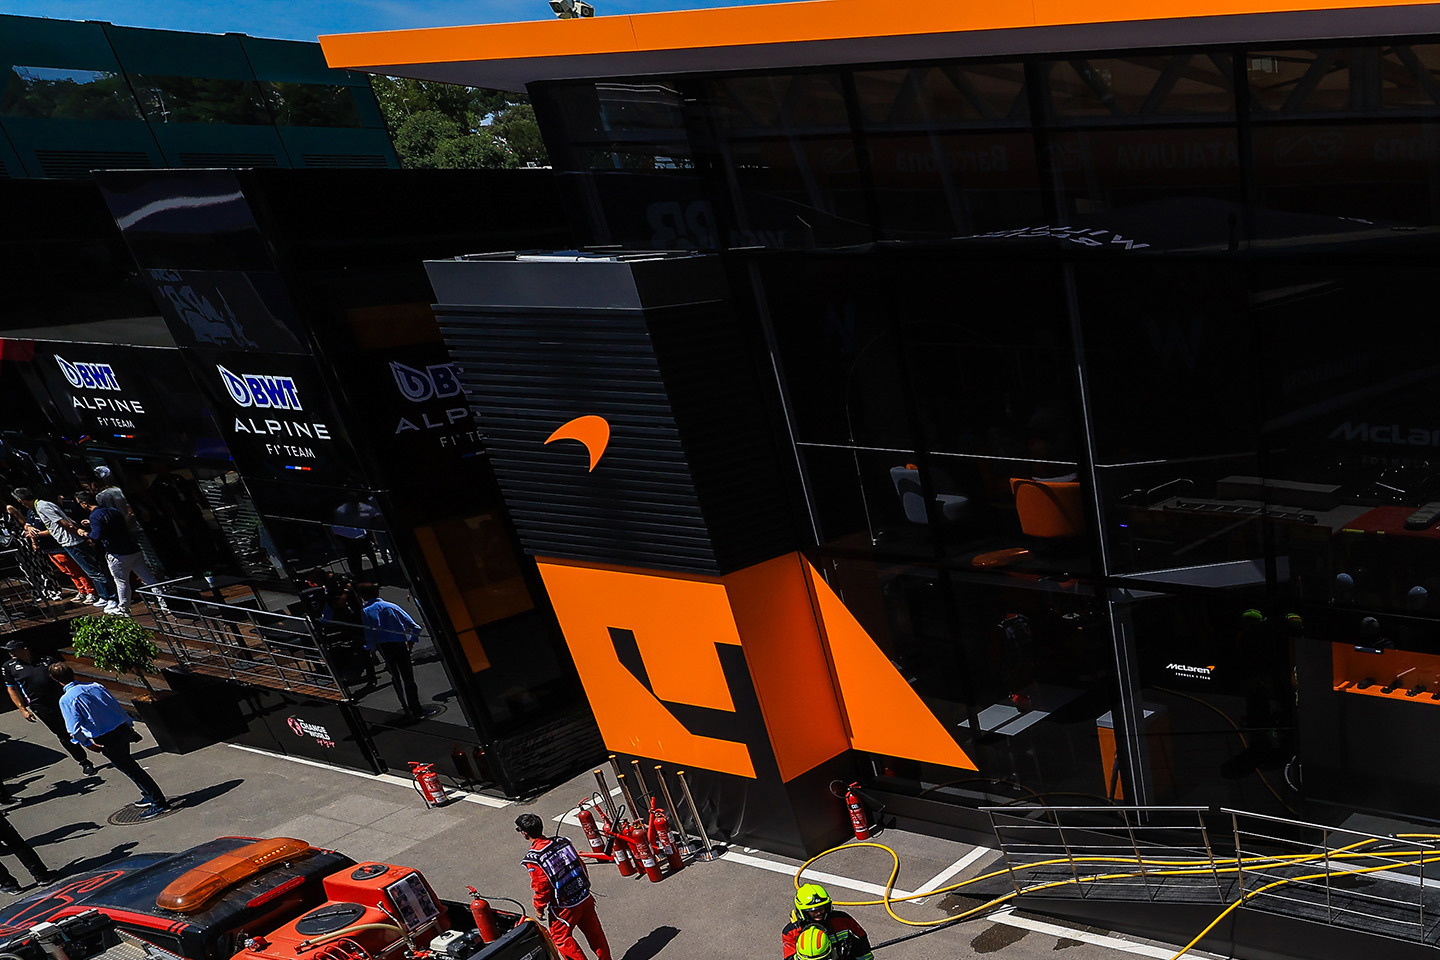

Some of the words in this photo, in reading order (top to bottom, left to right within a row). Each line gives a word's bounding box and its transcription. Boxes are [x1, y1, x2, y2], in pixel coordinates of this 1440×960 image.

[73, 361, 122, 391] BWT
[242, 374, 303, 411] BWT
[72, 396, 145, 414] ALPINE
[110, 417, 135, 429] TEAM
[234, 417, 331, 440] ALPINE
[395, 407, 482, 435] ALP
[283, 445, 316, 459] TEAM
[1165, 662, 1211, 675] McLaren
